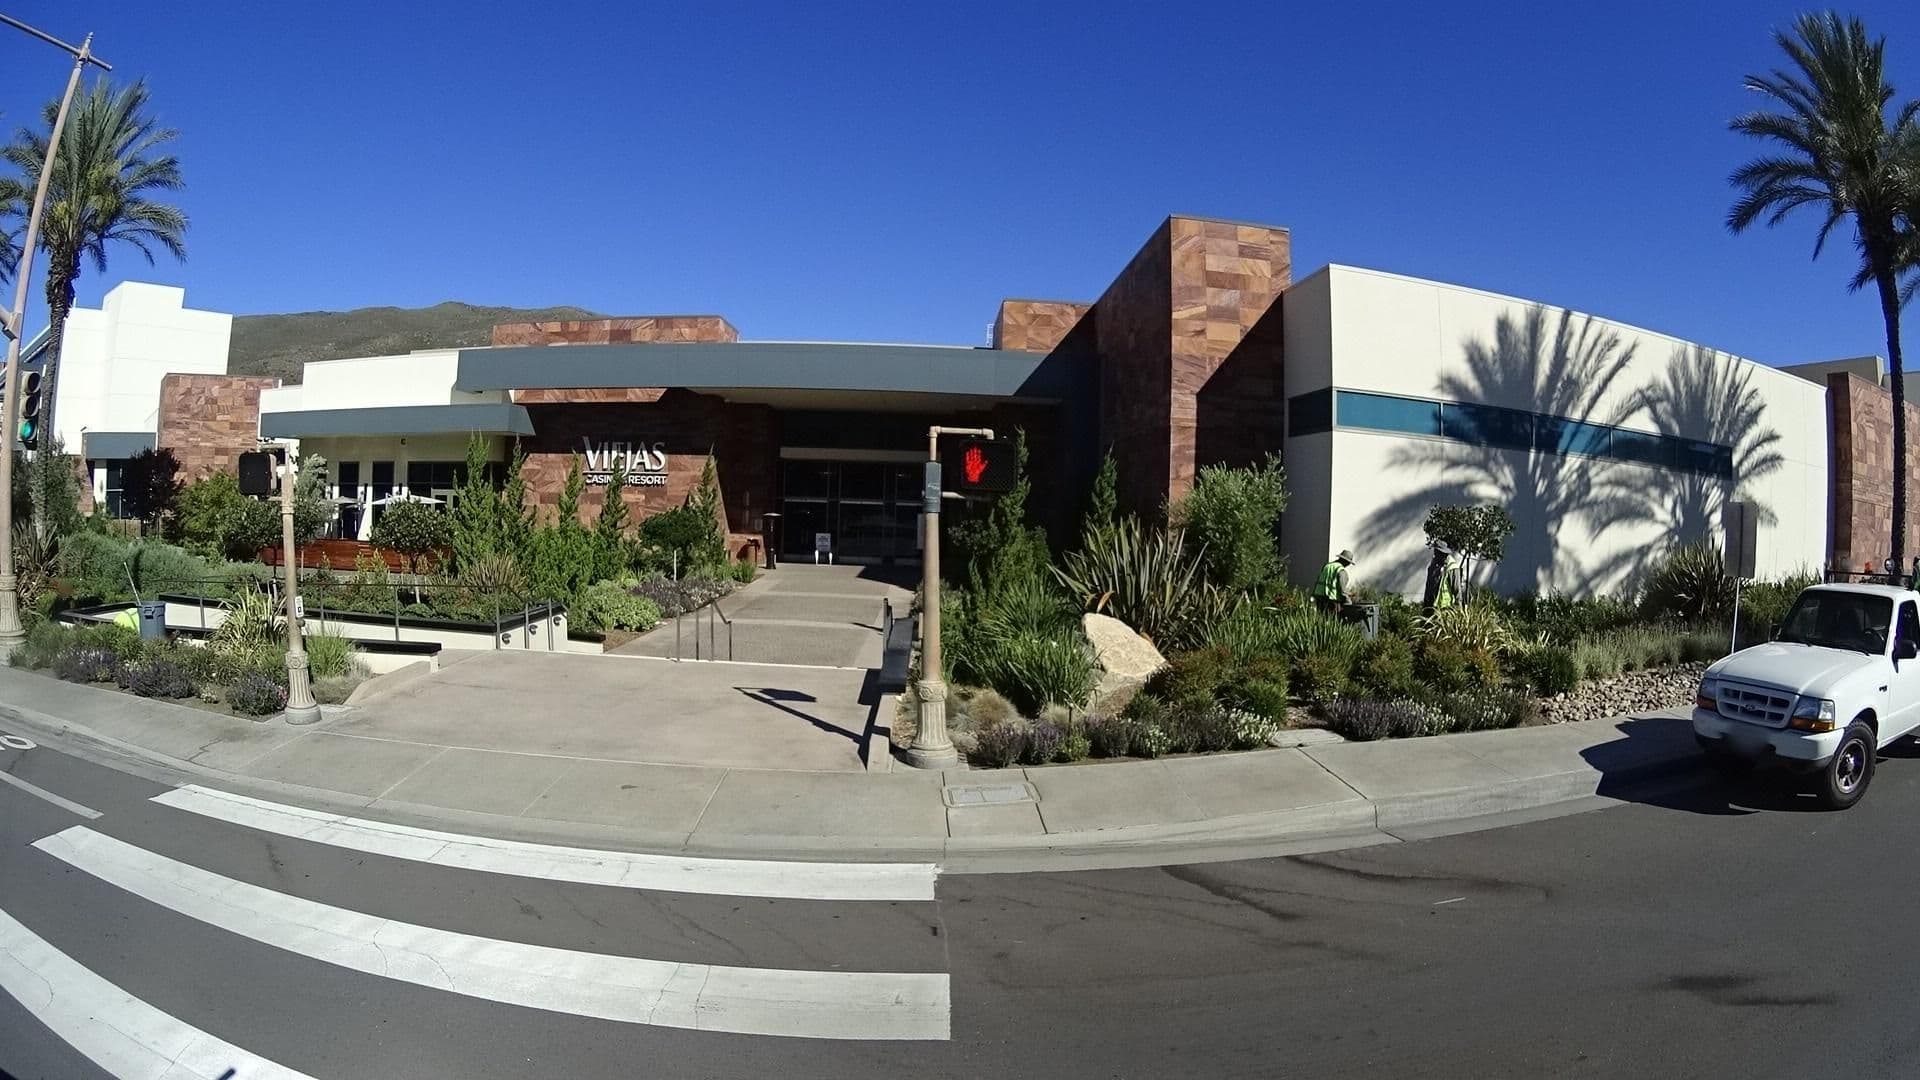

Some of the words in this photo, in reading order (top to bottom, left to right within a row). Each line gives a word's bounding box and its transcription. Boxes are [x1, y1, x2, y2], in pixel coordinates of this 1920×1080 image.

[582, 436, 666, 477] VIEJAS
[586, 475, 614, 485] CASIN
[629, 475, 667, 485] RESORT
